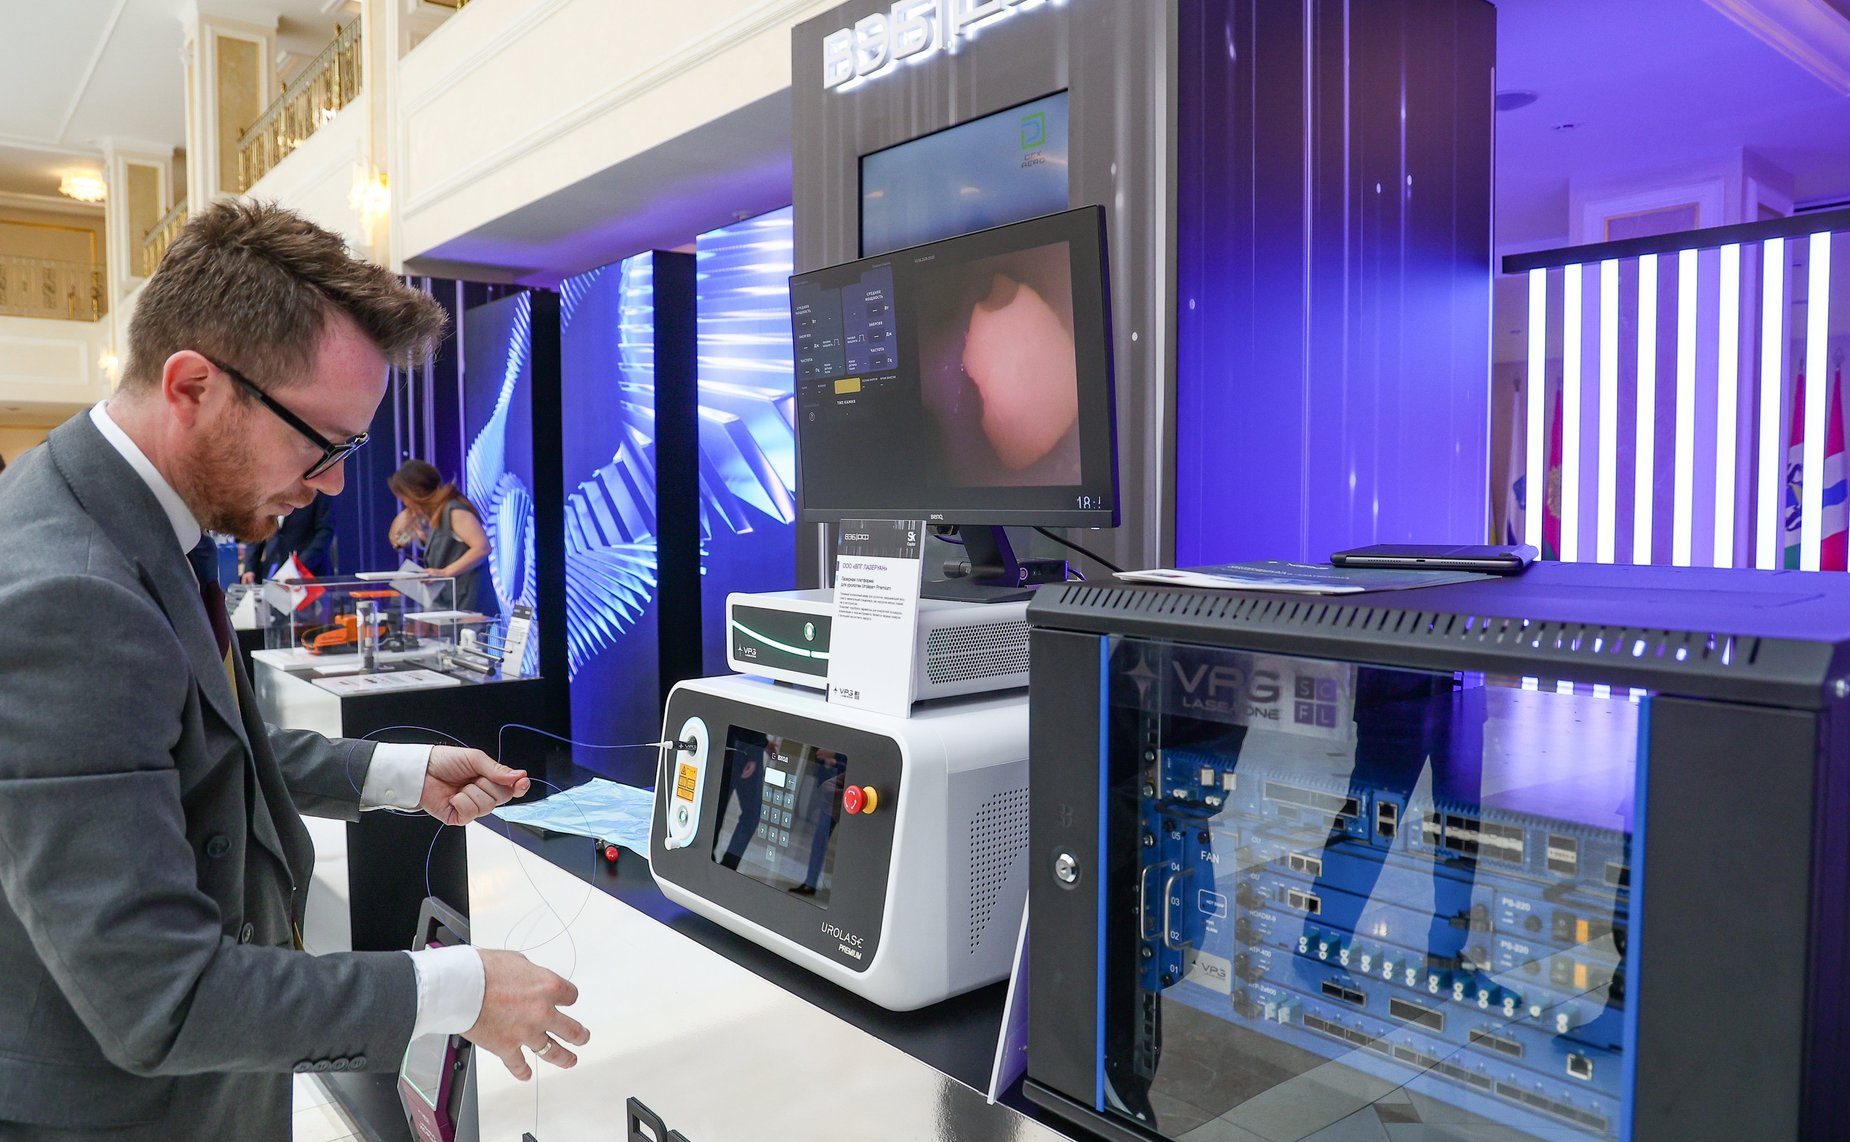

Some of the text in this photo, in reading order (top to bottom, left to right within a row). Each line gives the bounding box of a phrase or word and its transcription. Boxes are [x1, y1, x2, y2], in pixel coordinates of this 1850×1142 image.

[1172, 660, 1281, 703] VPG
[1172, 831, 1181, 840] 05
[1201, 850, 1220, 864] FAN
[1171, 862, 1180, 871] 04
[1171, 897, 1180, 906] 03
[1171, 931, 1179, 940] 02
[839, 944, 862, 960] PREMIUM
[1170, 964, 1178, 973] 01
